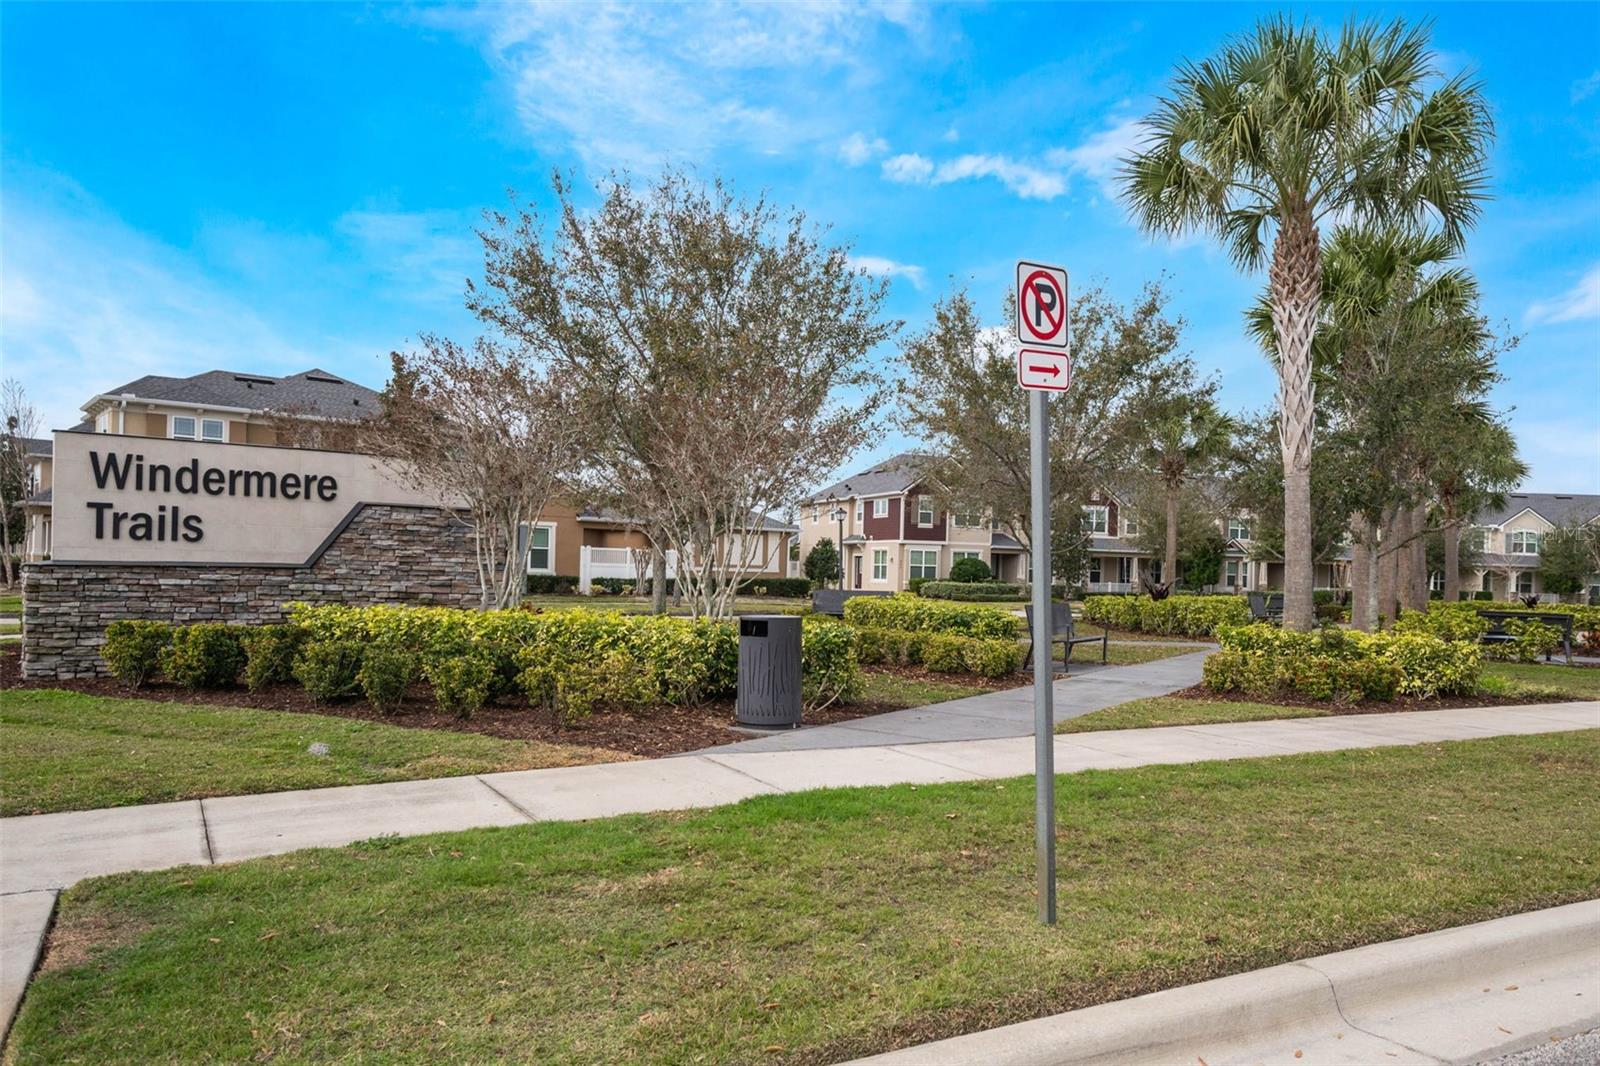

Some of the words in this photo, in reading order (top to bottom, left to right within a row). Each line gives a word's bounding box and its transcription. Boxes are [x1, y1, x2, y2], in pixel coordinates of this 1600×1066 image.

[1035, 283, 1057, 326] P
[89, 451, 338, 502] Windermere
[86, 501, 204, 543] Trails
